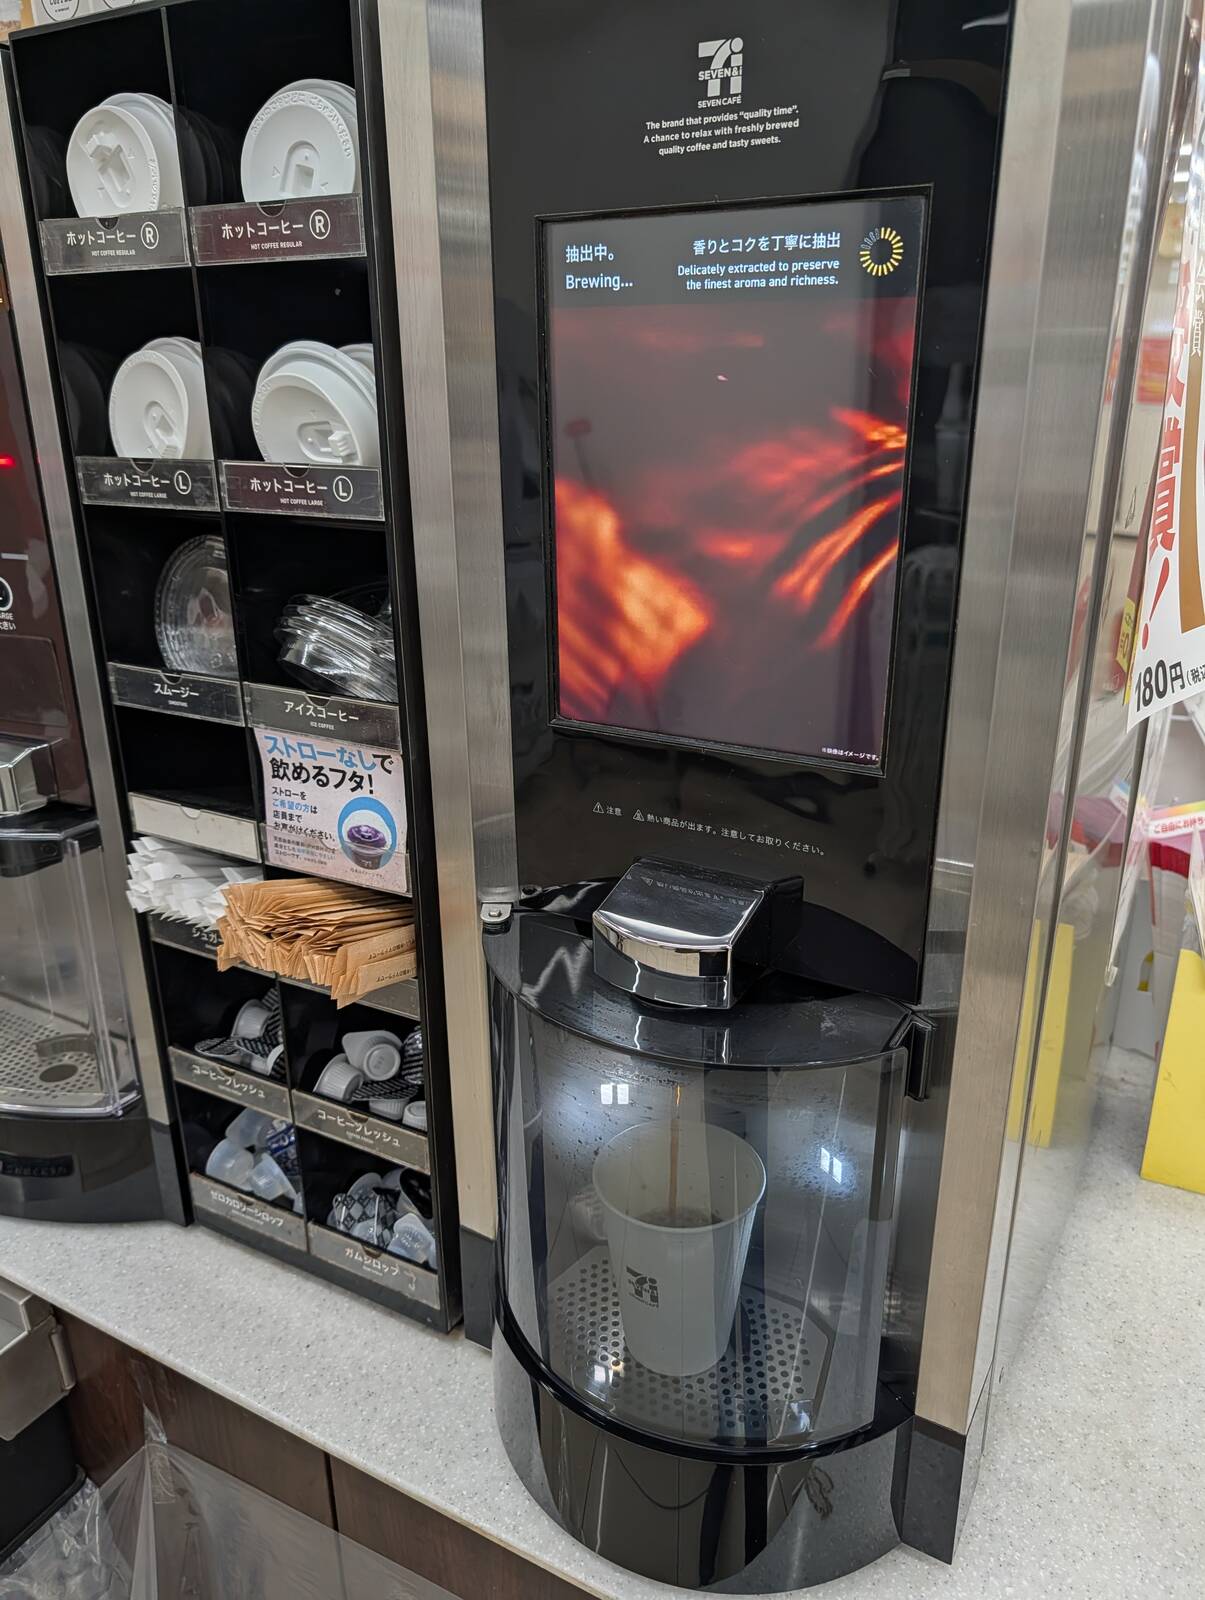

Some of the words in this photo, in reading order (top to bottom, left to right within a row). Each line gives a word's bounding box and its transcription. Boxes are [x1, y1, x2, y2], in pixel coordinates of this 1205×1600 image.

[645, 121, 660, 130] The
[661, 118, 685, 129] brand
[686, 117, 702, 126] that
[703, 112, 738, 126] provides
[643, 135, 650, 144] A
[650, 132, 680, 143] chance
[681, 131, 690, 140] to
[691, 128, 713, 139] relax
[714, 126, 733, 136] with
[734, 121, 765, 134] freshly
[765, 118, 800, 131] brewed
[658, 145, 686, 156] quality
[686, 142, 711, 153] coffee
[712, 140, 728, 150] and
[728, 138, 750, 150] tasty
[750, 135, 782, 146] sweets.
[66, 229, 136, 247] ホットコーヒー
[222, 219, 304, 241] ホットコーヒー
[261, 242, 280, 250] COFFEE
[280, 240, 303, 249] REGULAR
[692, 231, 841, 256] 香りとコクを丁寧に抽出
[565, 243, 614, 264] 抽出中。
[677, 262, 726, 277] Delicately
[728, 261, 777, 275] extracted
[778, 261, 789, 273] to
[791, 259, 840, 274] preserve
[565, 274, 634, 292] Brewing...
[686, 277, 702, 290] the
[703, 277, 732, 290] finest
[734, 277, 766, 288] aroma
[768, 275, 788, 288] and
[790, 274, 839, 287] richness.
[104, 472, 170, 488] ホットコーヒー
[250, 477, 328, 495] ホットコーヒー
[290, 498, 307, 506] COFFEE
[307, 499, 324, 507] LARGE
[153, 682, 200, 698] スムージー
[283, 700, 360, 723] アイスコーヒー
[263, 735, 395, 776] ストローなしで
[271, 786, 307, 801] ストローを
[273, 810, 303, 824] 店員まで
[606, 805, 622, 817] 注意
[192, 1064, 266, 1098] コーヒーフレッシュ
[317, 1109, 401, 1148] コーヒーフレッシュ
[344, 1247, 400, 1276] ガムシロップ
